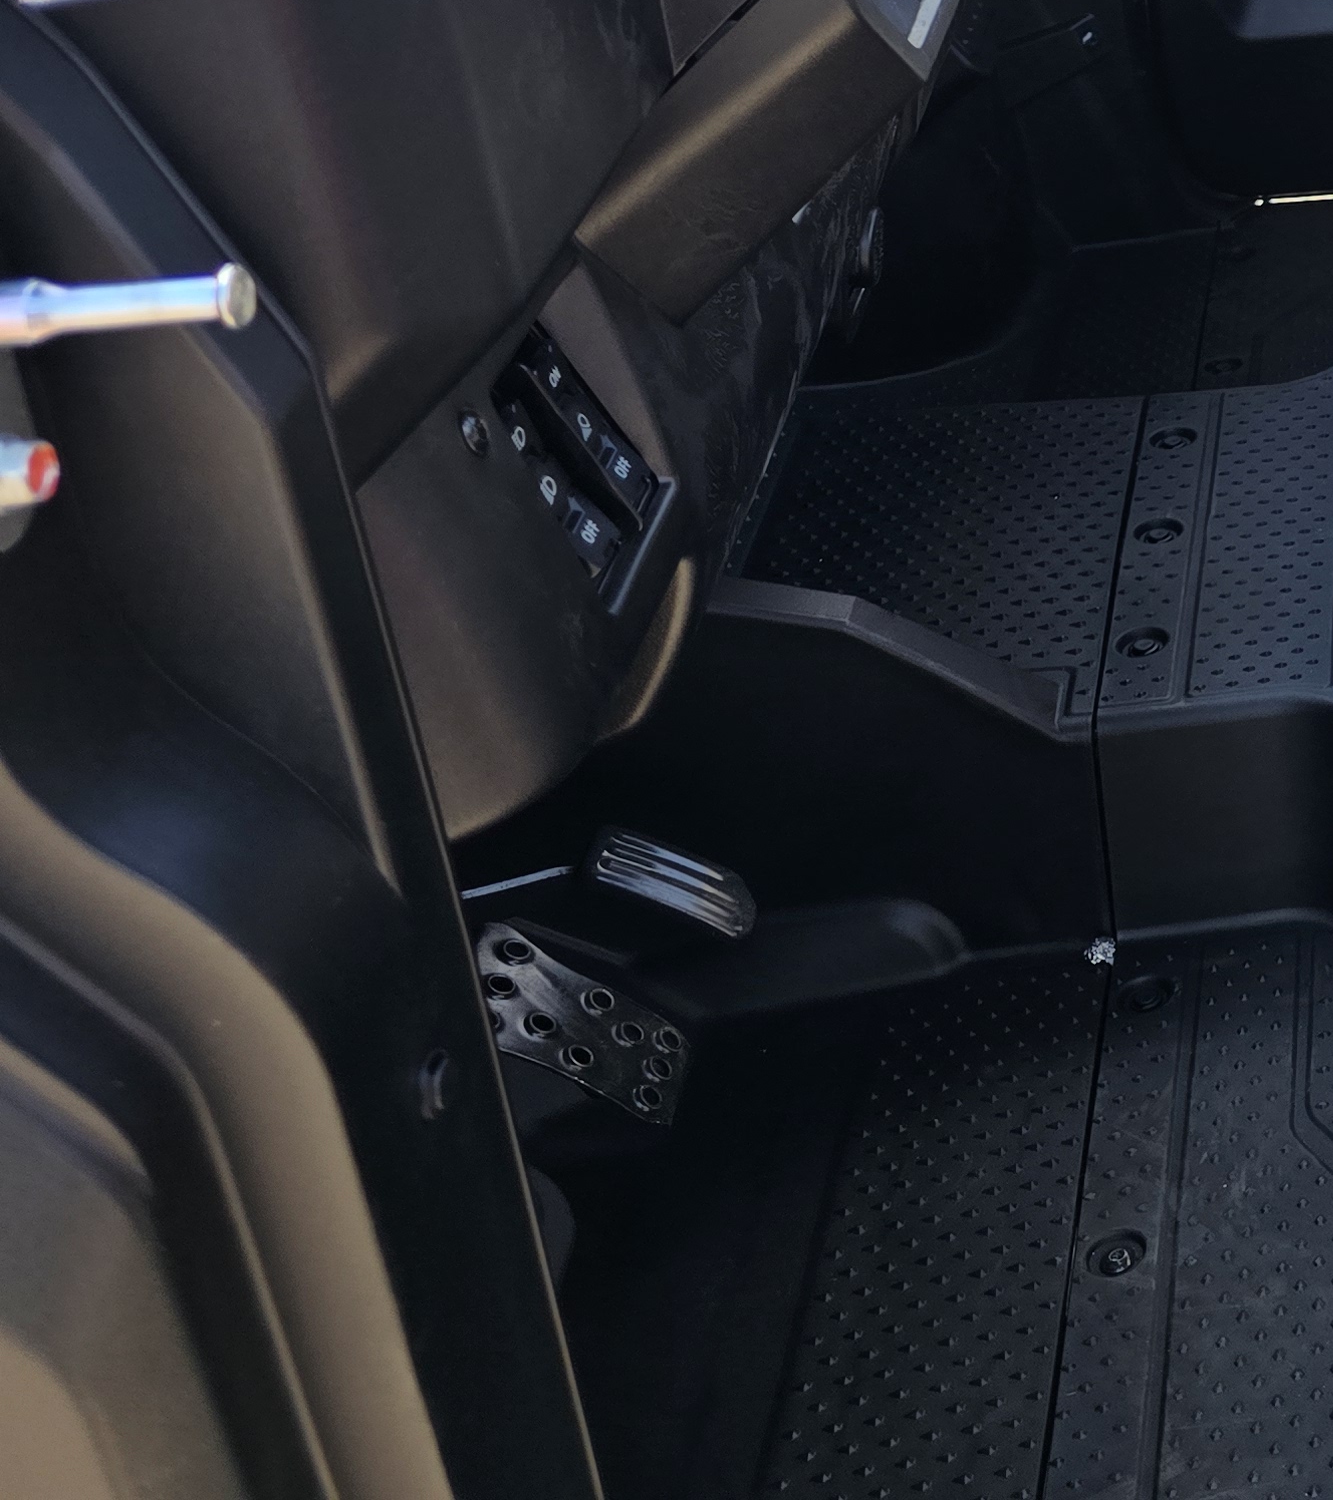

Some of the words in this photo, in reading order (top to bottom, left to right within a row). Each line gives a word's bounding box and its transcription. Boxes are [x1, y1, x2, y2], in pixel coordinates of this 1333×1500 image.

[549, 365, 562, 388] ON
[614, 456, 632, 480] OFF
[580, 519, 600, 545] OFF
